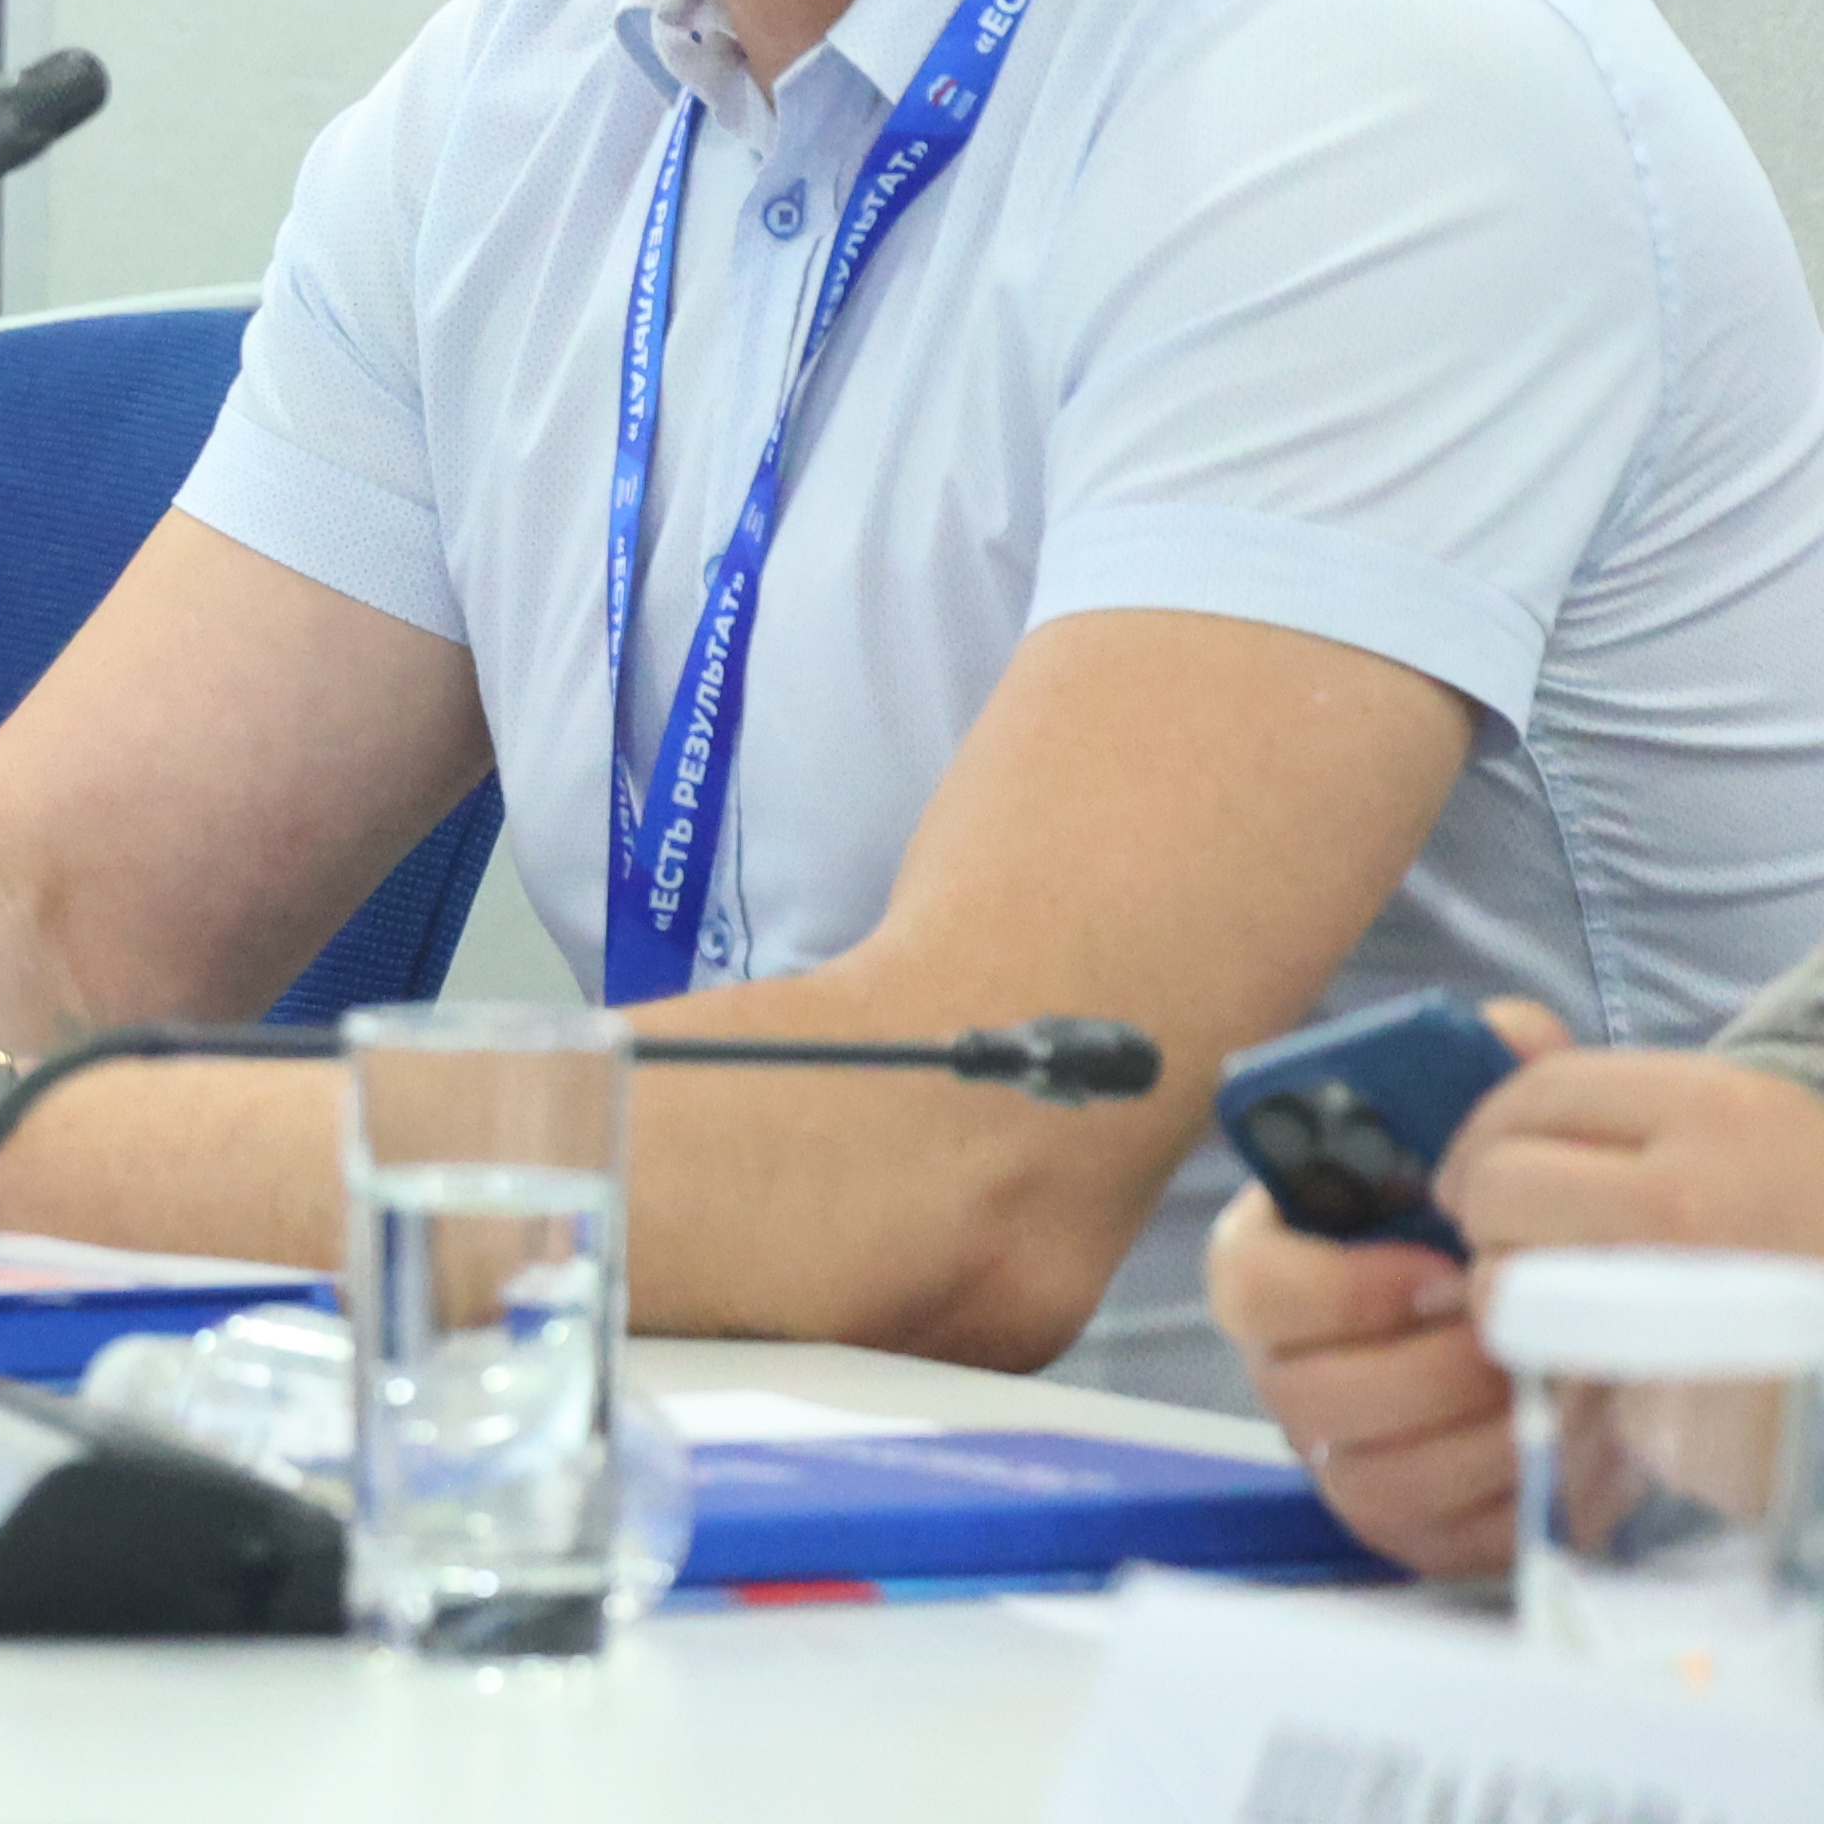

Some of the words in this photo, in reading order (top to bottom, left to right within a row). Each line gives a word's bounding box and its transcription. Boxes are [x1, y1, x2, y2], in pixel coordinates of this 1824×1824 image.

[627, 198, 669, 442] РЕЗУЛЬТАТ»
[649, 819, 694, 932] «ЕСТЬ
[672, 570, 746, 809] РЕЗУЛЬТАТ»
